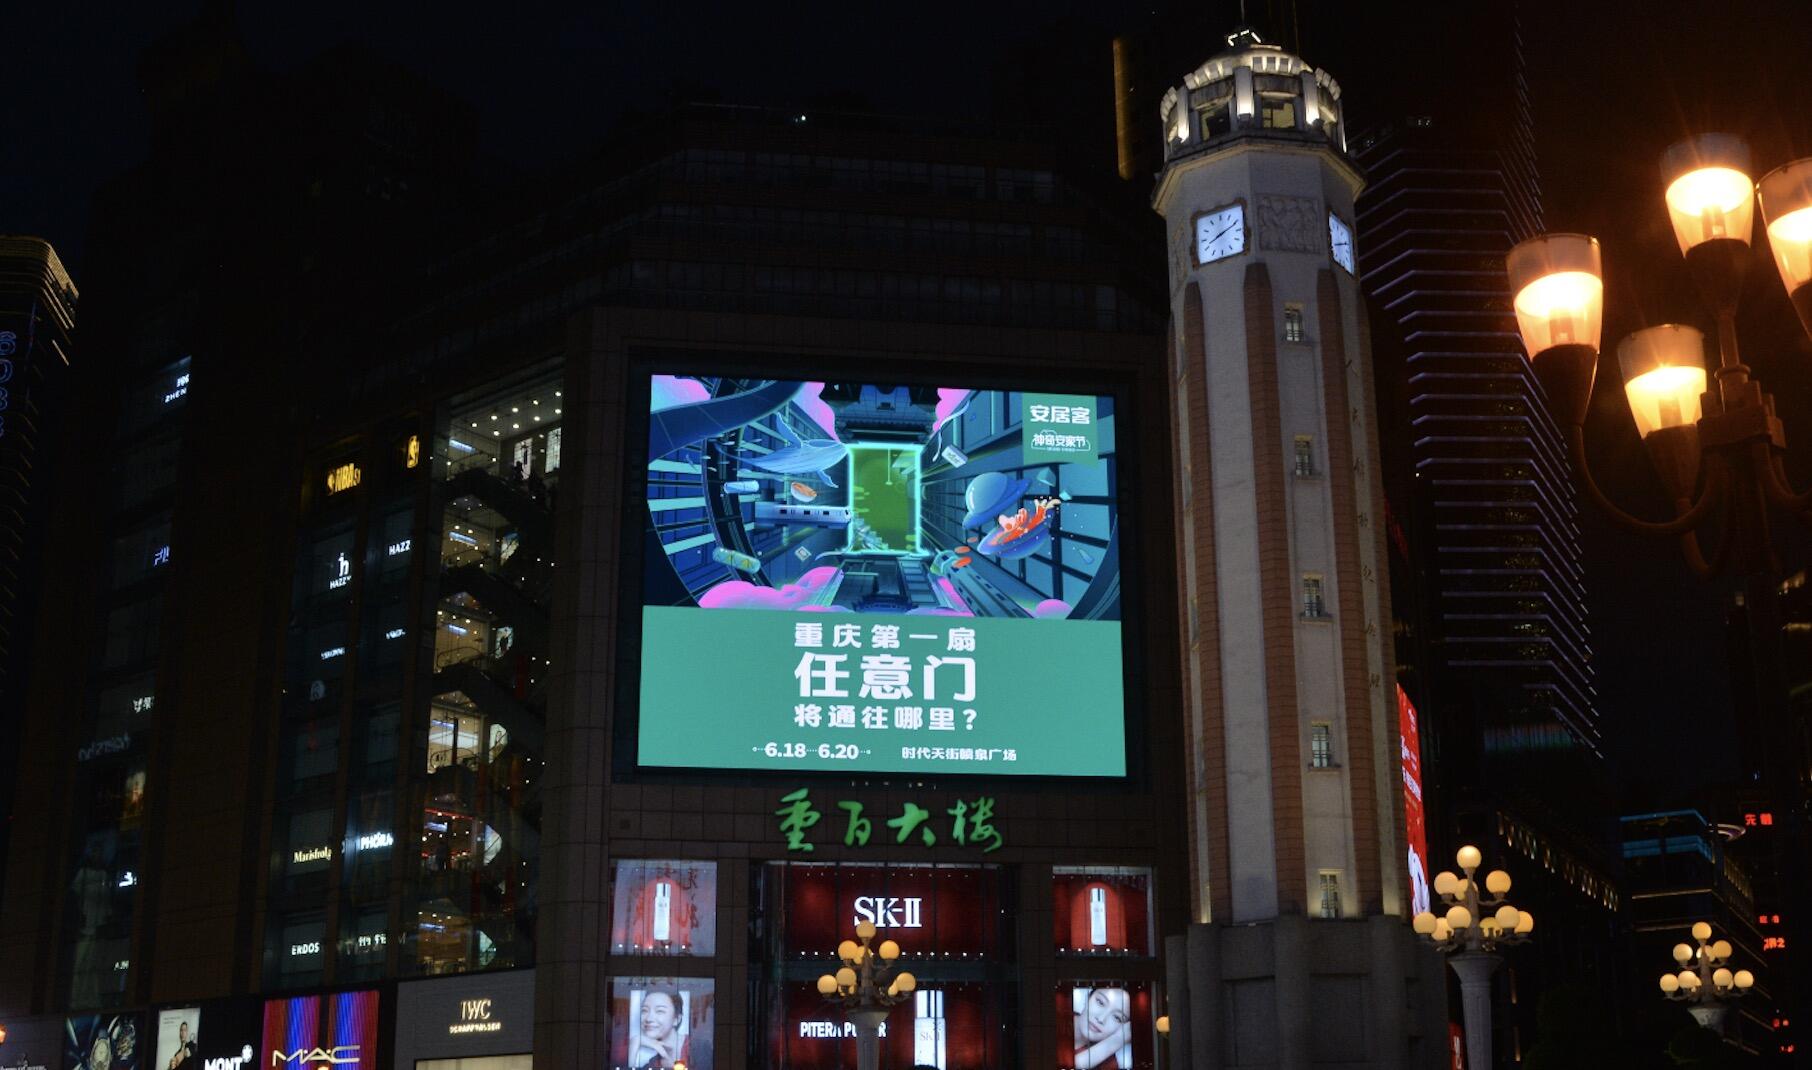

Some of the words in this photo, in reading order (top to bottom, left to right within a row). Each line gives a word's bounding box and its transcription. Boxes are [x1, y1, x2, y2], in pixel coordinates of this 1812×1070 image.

[1029, 404, 1090, 425] 安居客
[794, 623, 977, 652] 重庆第一扇
[793, 651, 977, 702] 任意门
[775, 787, 1003, 853] 重百大楼
[461, 999, 491, 1020] IWC
[800, 1021, 842, 1038] PITERA
